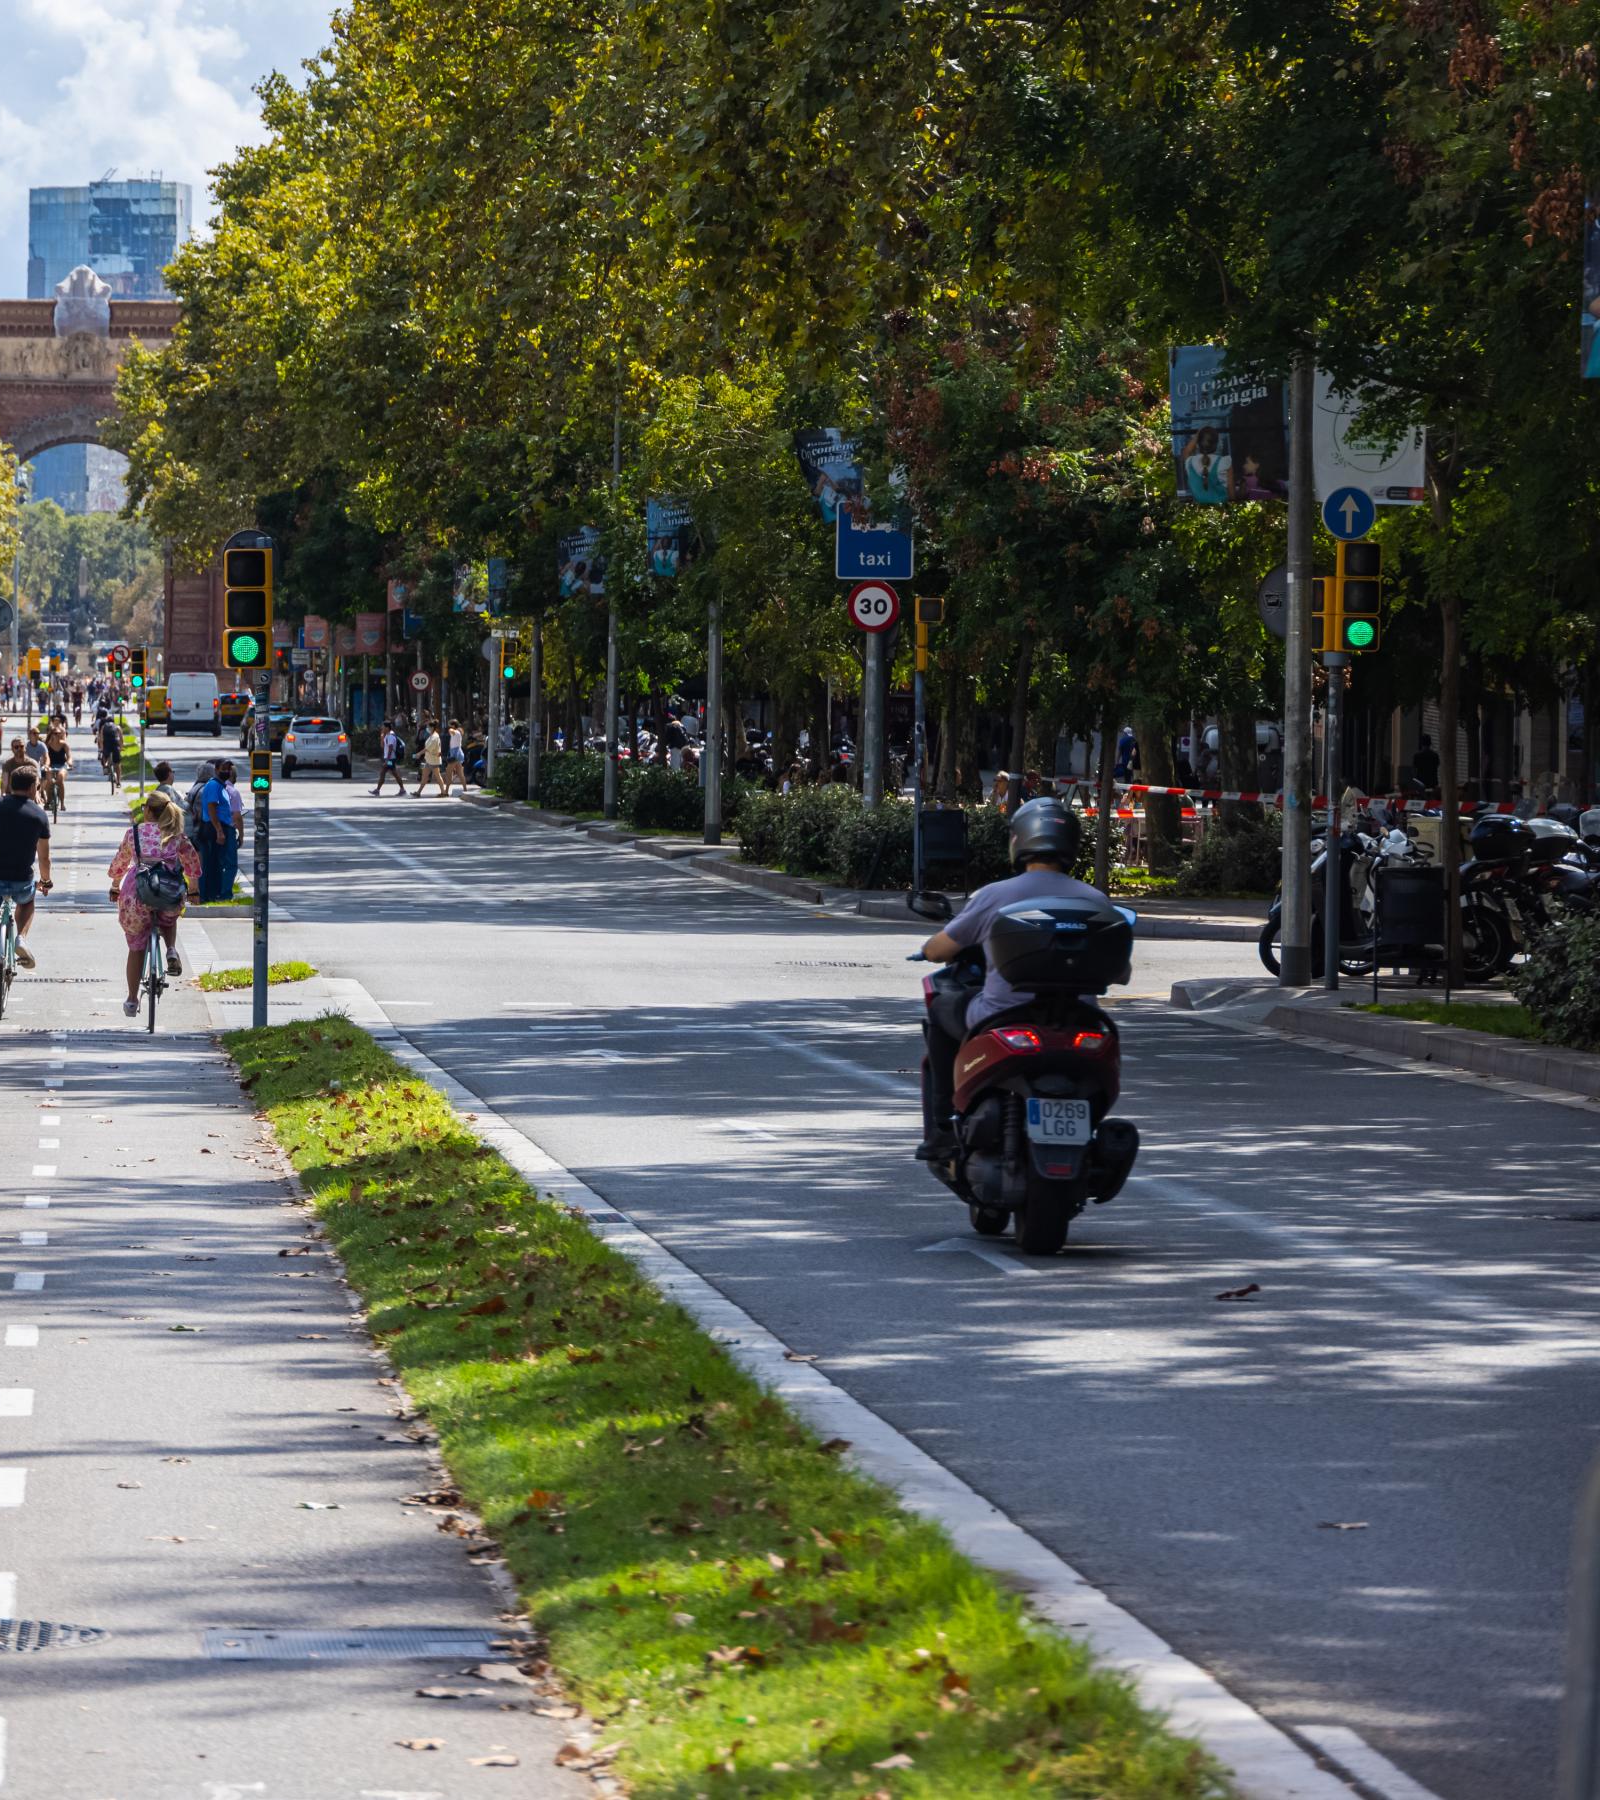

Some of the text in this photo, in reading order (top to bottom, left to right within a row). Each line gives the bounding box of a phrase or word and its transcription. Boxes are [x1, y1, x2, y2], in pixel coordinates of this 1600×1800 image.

[1177, 380, 1198, 397] On
[1195, 395, 1207, 411] la
[859, 551, 891, 566] taxi
[859, 598, 888, 615] 30
[414, 677, 427, 686] 30
[1055, 922, 1088, 930] SHAD
[1042, 1102, 1087, 1120] 0269
[1042, 1120, 1077, 1137] LGG
